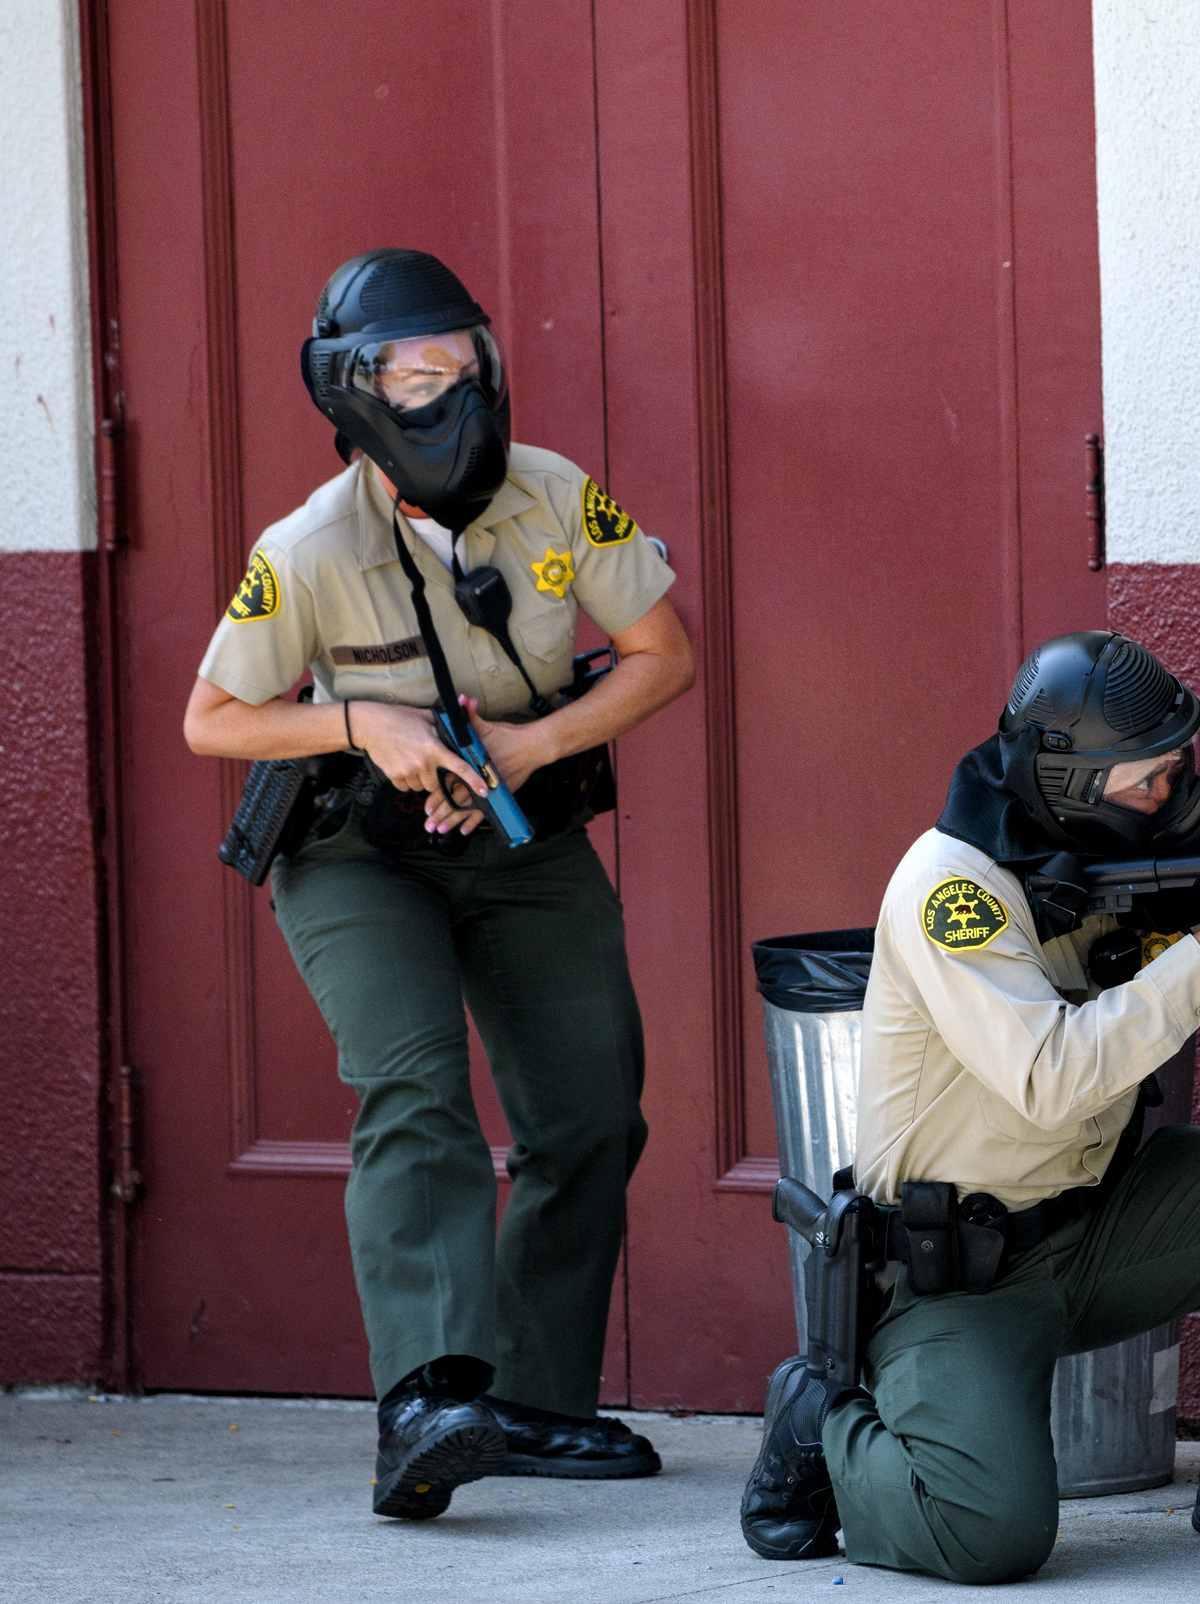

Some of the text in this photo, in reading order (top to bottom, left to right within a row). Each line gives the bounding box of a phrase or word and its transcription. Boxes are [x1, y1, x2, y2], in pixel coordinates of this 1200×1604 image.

[588, 519, 604, 541] LOS
[261, 572, 275, 615] COUNTY
[352, 641, 419, 663] NICHOLSON
[926, 883, 1005, 931] LOS ANGELES COUNTY
[944, 926, 990, 943] SHERIFF
